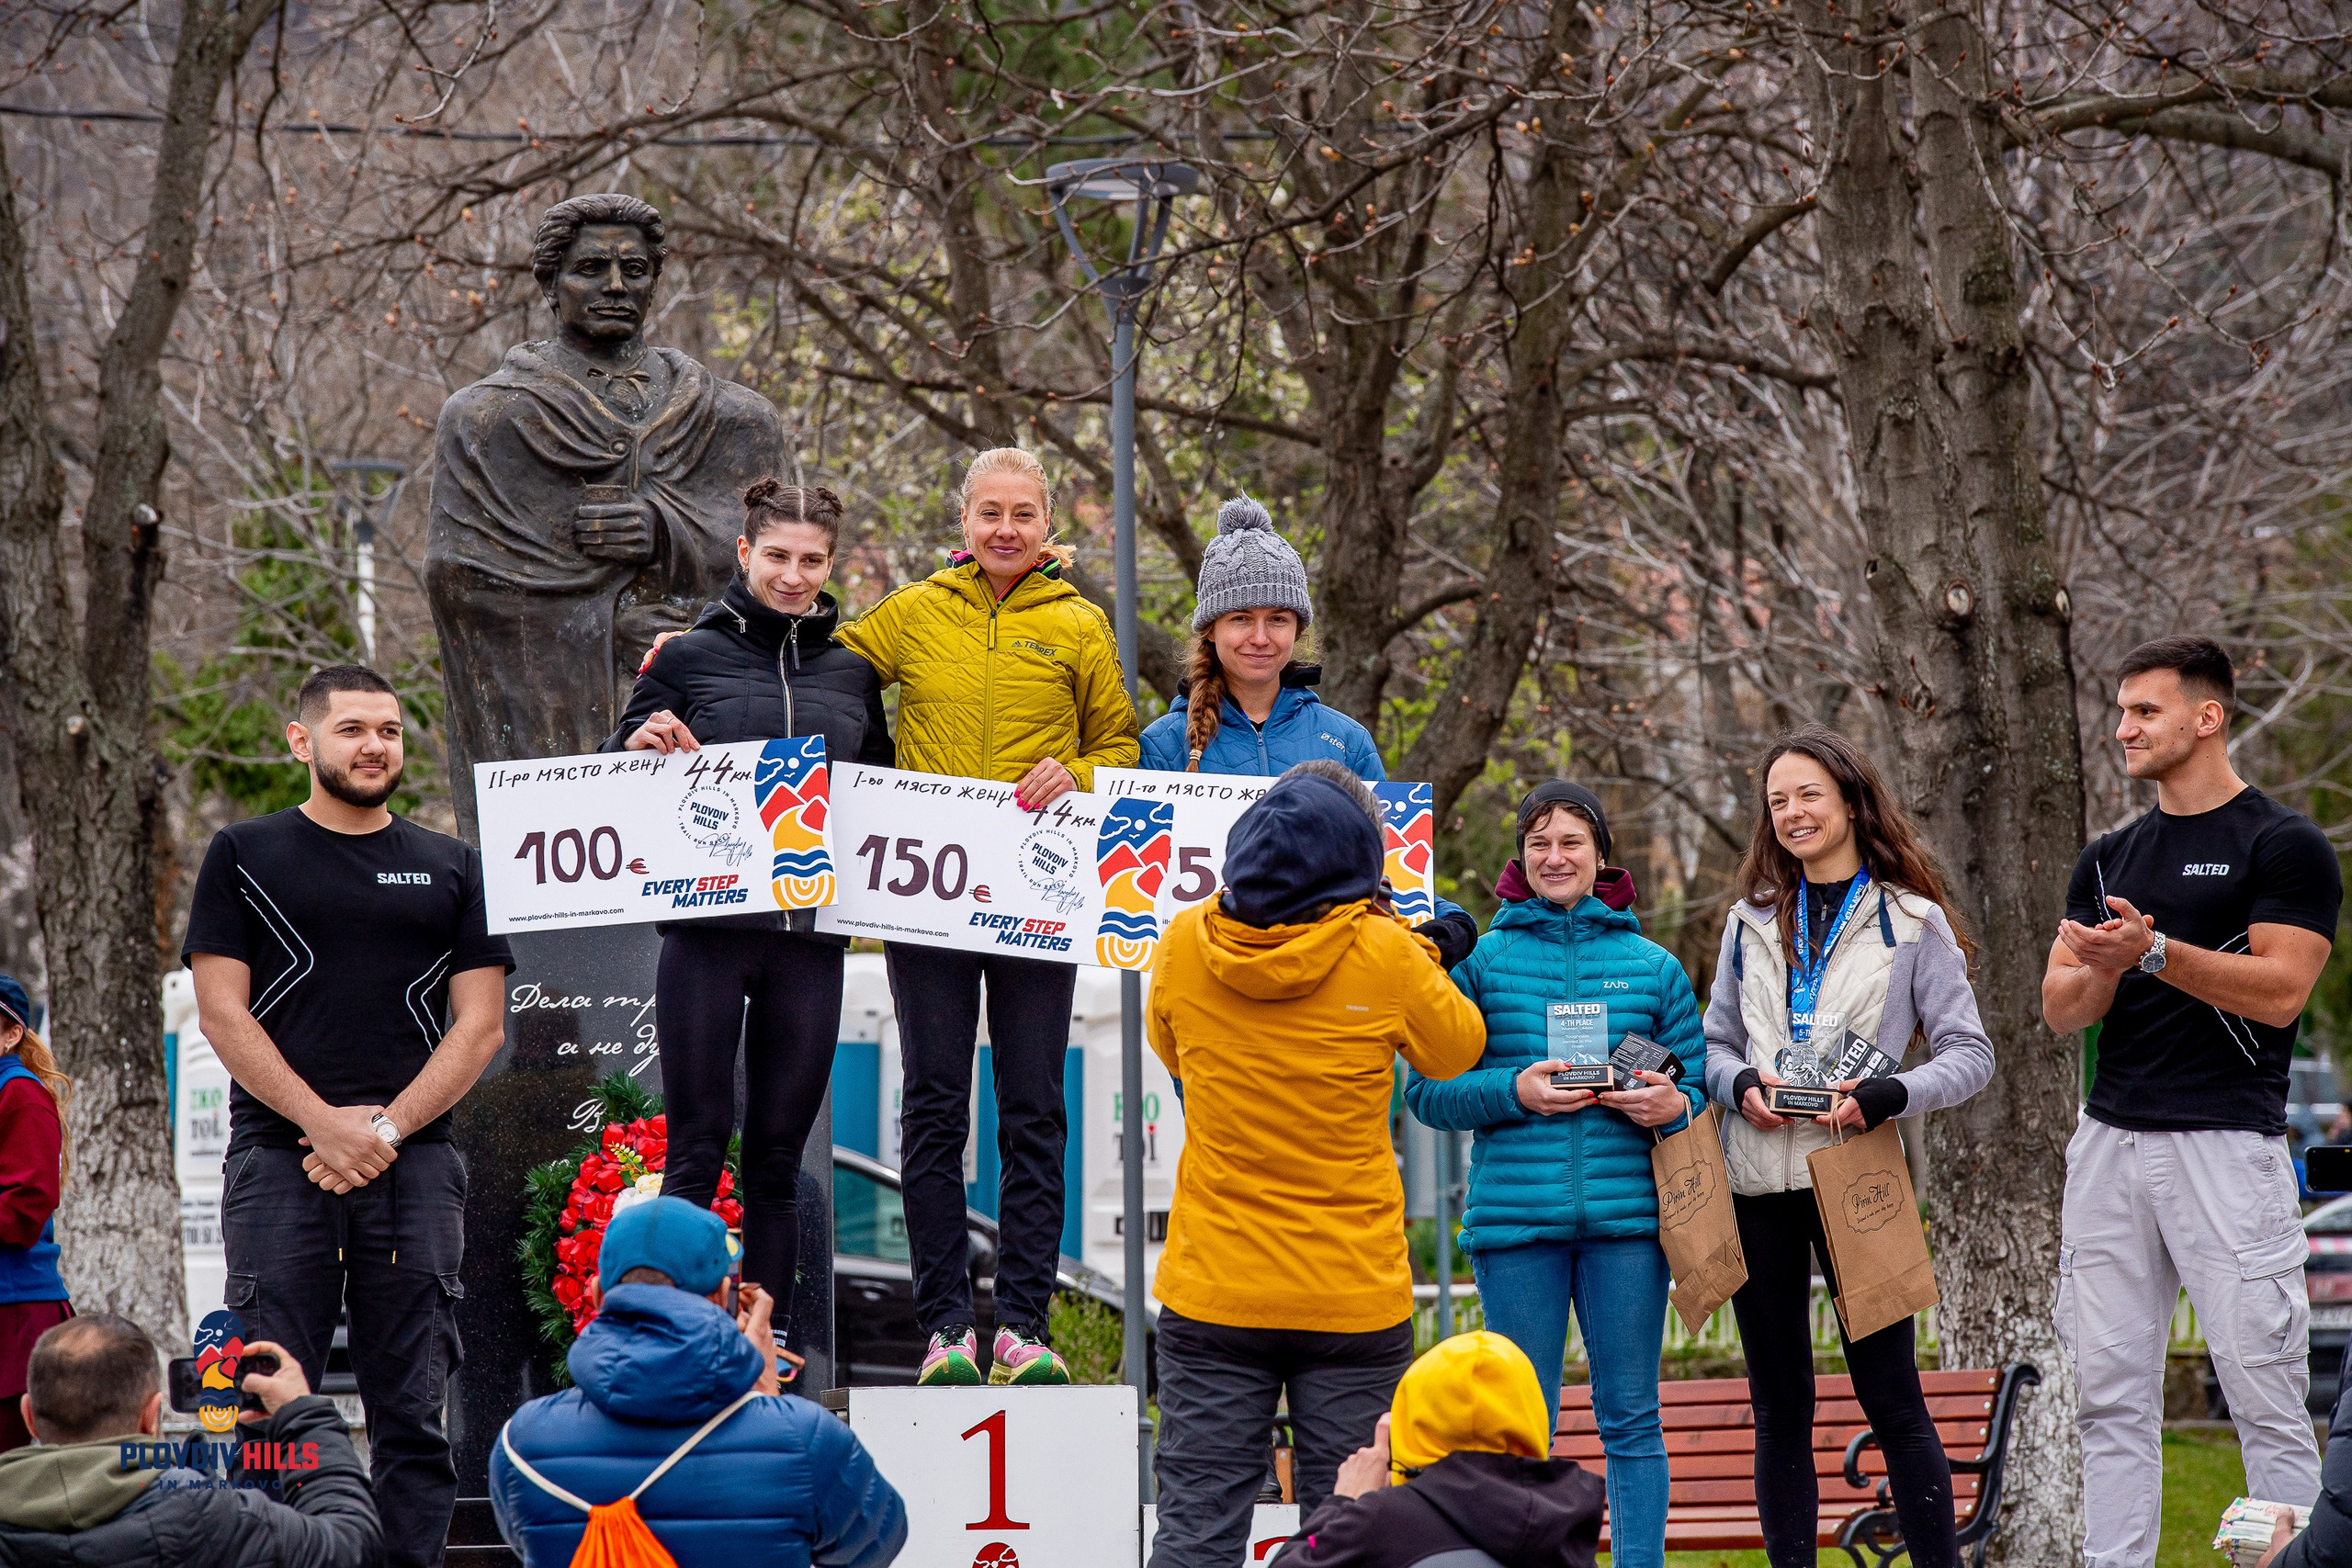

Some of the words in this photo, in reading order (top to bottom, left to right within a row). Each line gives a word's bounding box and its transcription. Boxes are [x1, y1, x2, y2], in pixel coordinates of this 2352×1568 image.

[1024, 641, 1057, 656] TERREX
[537, 764, 602, 782] МЯСТО
[684, 752, 736, 790] 44
[1166, 784, 1233, 799] МЯСТО
[1238, 788, 1267, 801] ЖЕ
[690, 801, 729, 821] PLOVDIV
[895, 780, 952, 795] МЯСТО
[1026, 799, 1073, 827] 44
[693, 815, 718, 830] HILLS
[1032, 842, 1069, 868] PLOVDIV
[1032, 856, 1057, 874] HILLS
[377, 873, 431, 885] SALTED
[2182, 863, 2230, 875] SALTED
[641, 878, 696, 897] EVERY
[695, 874, 739, 892] STEP
[672, 888, 749, 908] MATTERS
[509, 908, 624, 921] www.plovdiv-hills-in-markovo.com
[968, 912, 1024, 931] EVERY
[1022, 919, 1066, 935] STEP
[837, 919, 949, 937] www.plovdiv-hills-in-markovo.com
[995, 931, 1072, 952] MATTERS
[510, 982, 592, 1013] Дела
[603, 993, 656, 1027] тр
[1554, 1004, 1600, 1016] SALTED
[1792, 1012, 1838, 1027] SALTED
[558, 1042, 579, 1055] а
[589, 1042, 623, 1055] не
[628, 1023, 660, 1077] ду
[1663, 1190, 1685, 1212] Pirin
[1684, 1172, 1702, 1196] Hill
[1851, 1193, 1872, 1214] Pirin
[1868, 1182, 1890, 1203] Hill
[961, 1409, 1030, 1530] 1
